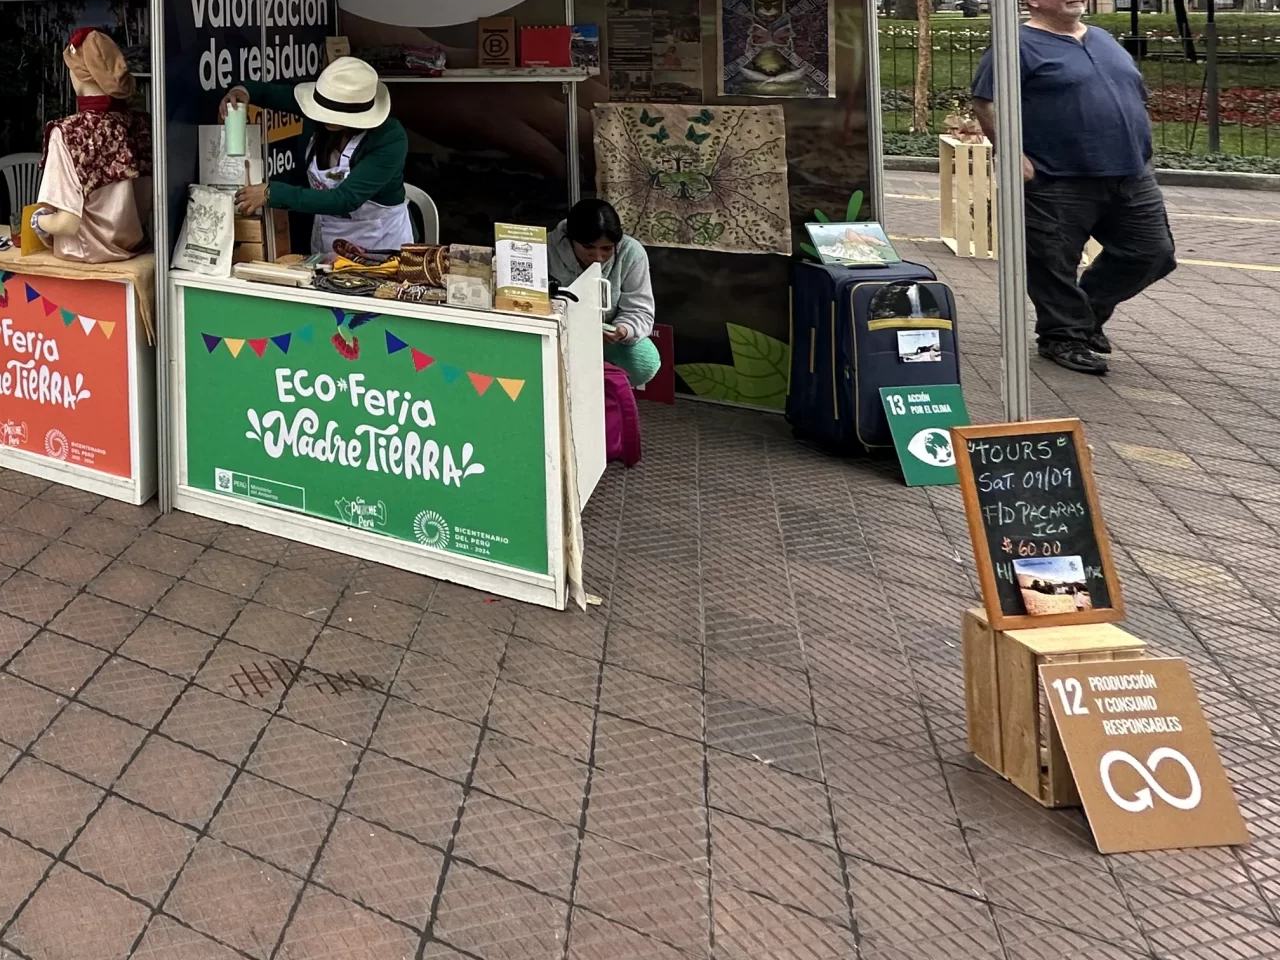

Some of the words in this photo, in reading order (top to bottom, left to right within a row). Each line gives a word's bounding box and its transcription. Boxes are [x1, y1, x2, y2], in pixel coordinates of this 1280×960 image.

[199, 37, 233, 91] de
[239, 34, 321, 83] residuo
[1, 318, 60, 362] Feria
[348, 373, 437, 428] Feria
[886, 394, 906, 416] 13
[907, 391, 931, 403] ACCIÓN
[910, 405, 924, 415] POR
[924, 405, 932, 414] EL
[931, 403, 953, 414] CLIMA
[262, 407, 362, 468] Madre
[454, 526, 509, 544] BICENTENARIO
[1031, 522, 1069, 537] ICA
[454, 534, 469, 543] DEL
[470, 537, 491, 548] PERÚ
[1051, 677, 1090, 716] 12
[1087, 669, 1158, 692] PRODUCCIÓN
[1094, 698, 1105, 713] Y
[1105, 695, 1158, 713] CONSUMO
[1102, 716, 1183, 736] RESPONSABLES
